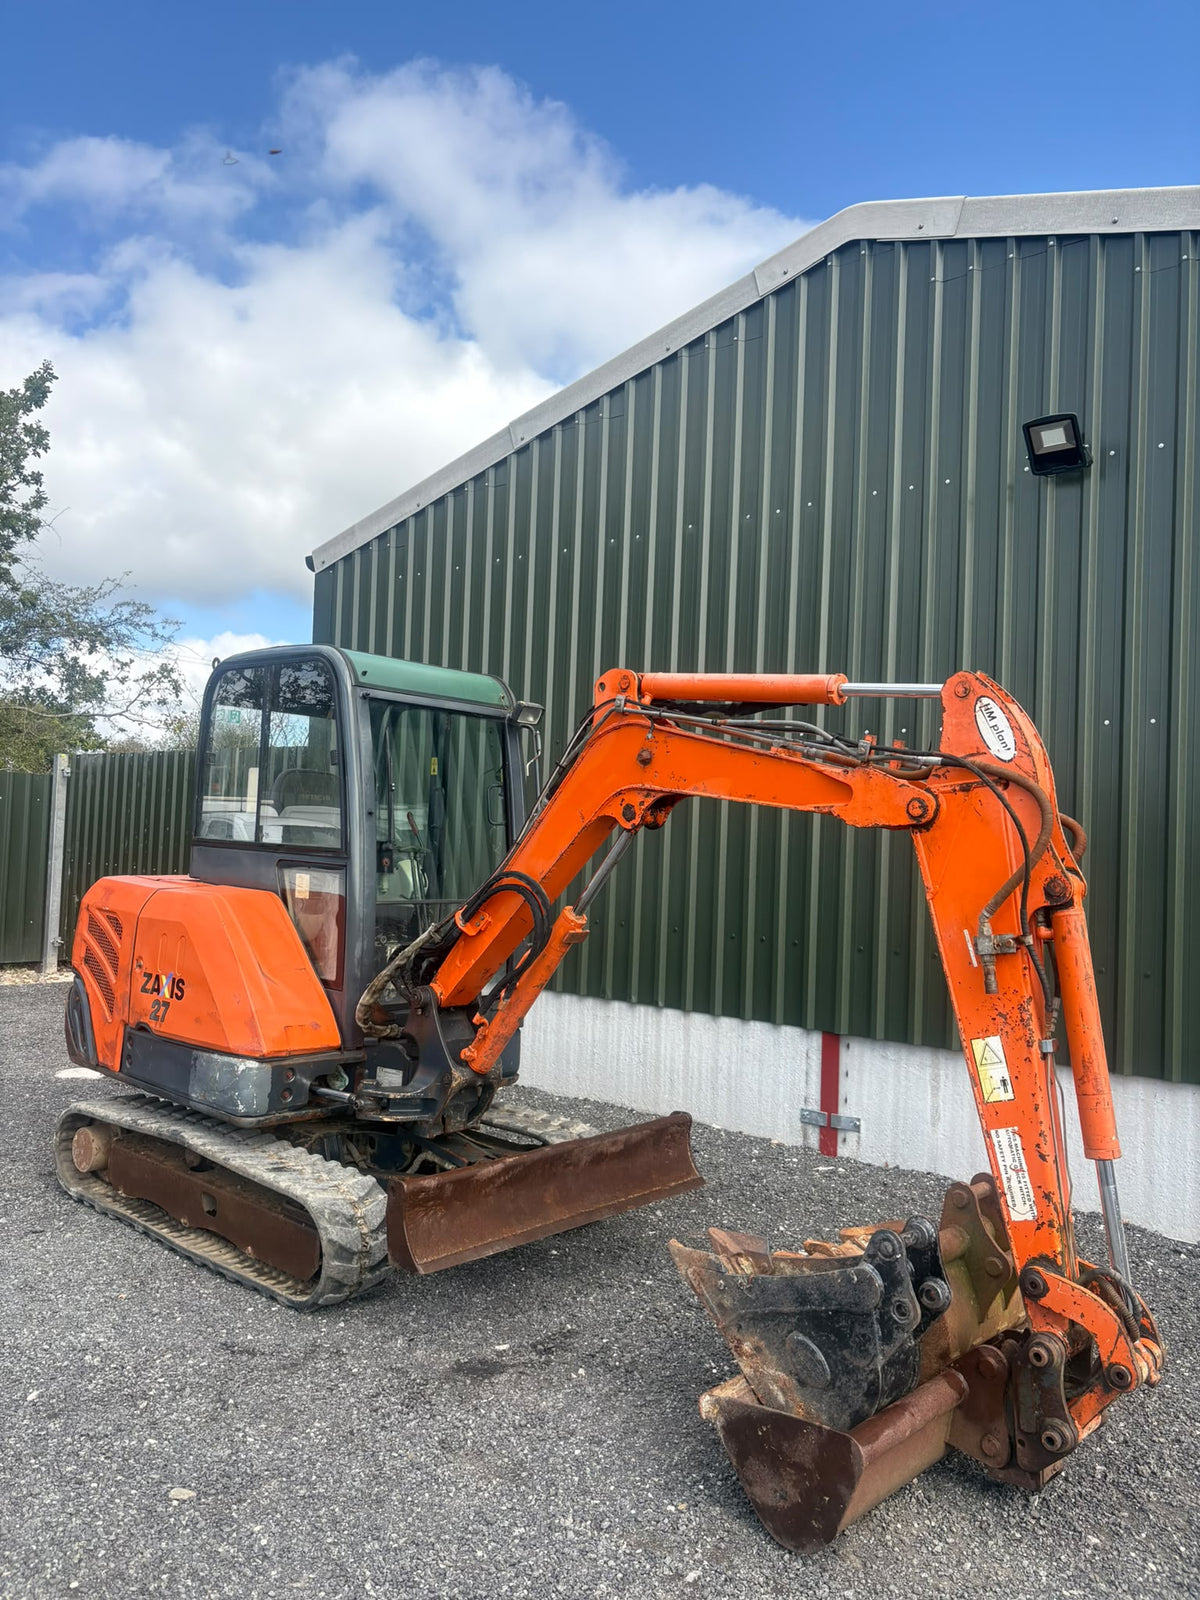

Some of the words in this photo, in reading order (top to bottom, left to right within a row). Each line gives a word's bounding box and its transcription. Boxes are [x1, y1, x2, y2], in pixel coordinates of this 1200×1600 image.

[982, 703, 997, 722] HM
[140, 972, 186, 1001] ZAXIS
[149, 999, 171, 1023] 27
[995, 1129, 1000, 1139] NO
[1005, 1129, 1017, 1163] AUTOMATIC
[996, 1140, 1006, 1163] SAFETY
[1014, 1143, 1024, 1170] MACHINE
[1022, 1180, 1032, 1203] FITTED
[1029, 1203, 1037, 1220] WITH
